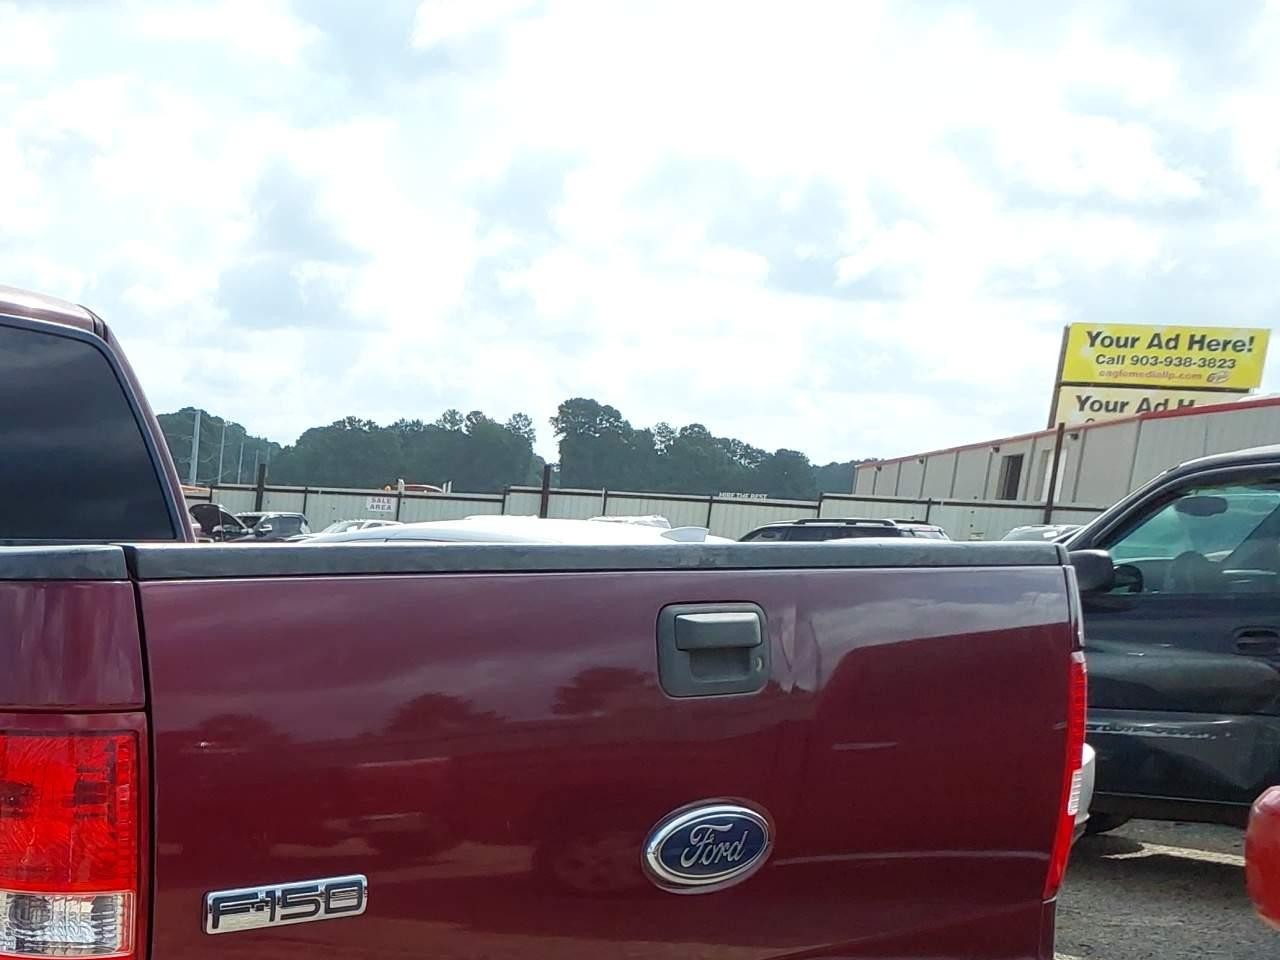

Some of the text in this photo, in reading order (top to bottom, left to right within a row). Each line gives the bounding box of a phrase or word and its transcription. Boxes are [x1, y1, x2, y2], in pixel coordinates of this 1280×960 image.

[1086, 330, 1255, 353] Your Ad Here!
[1095, 353, 1236, 369] Call 903-938-3823
[1075, 394, 1130, 414] Your
[1135, 397, 1170, 413] Ad
[370, 503, 393, 511] AREA
[680, 823, 749, 868] Ford
